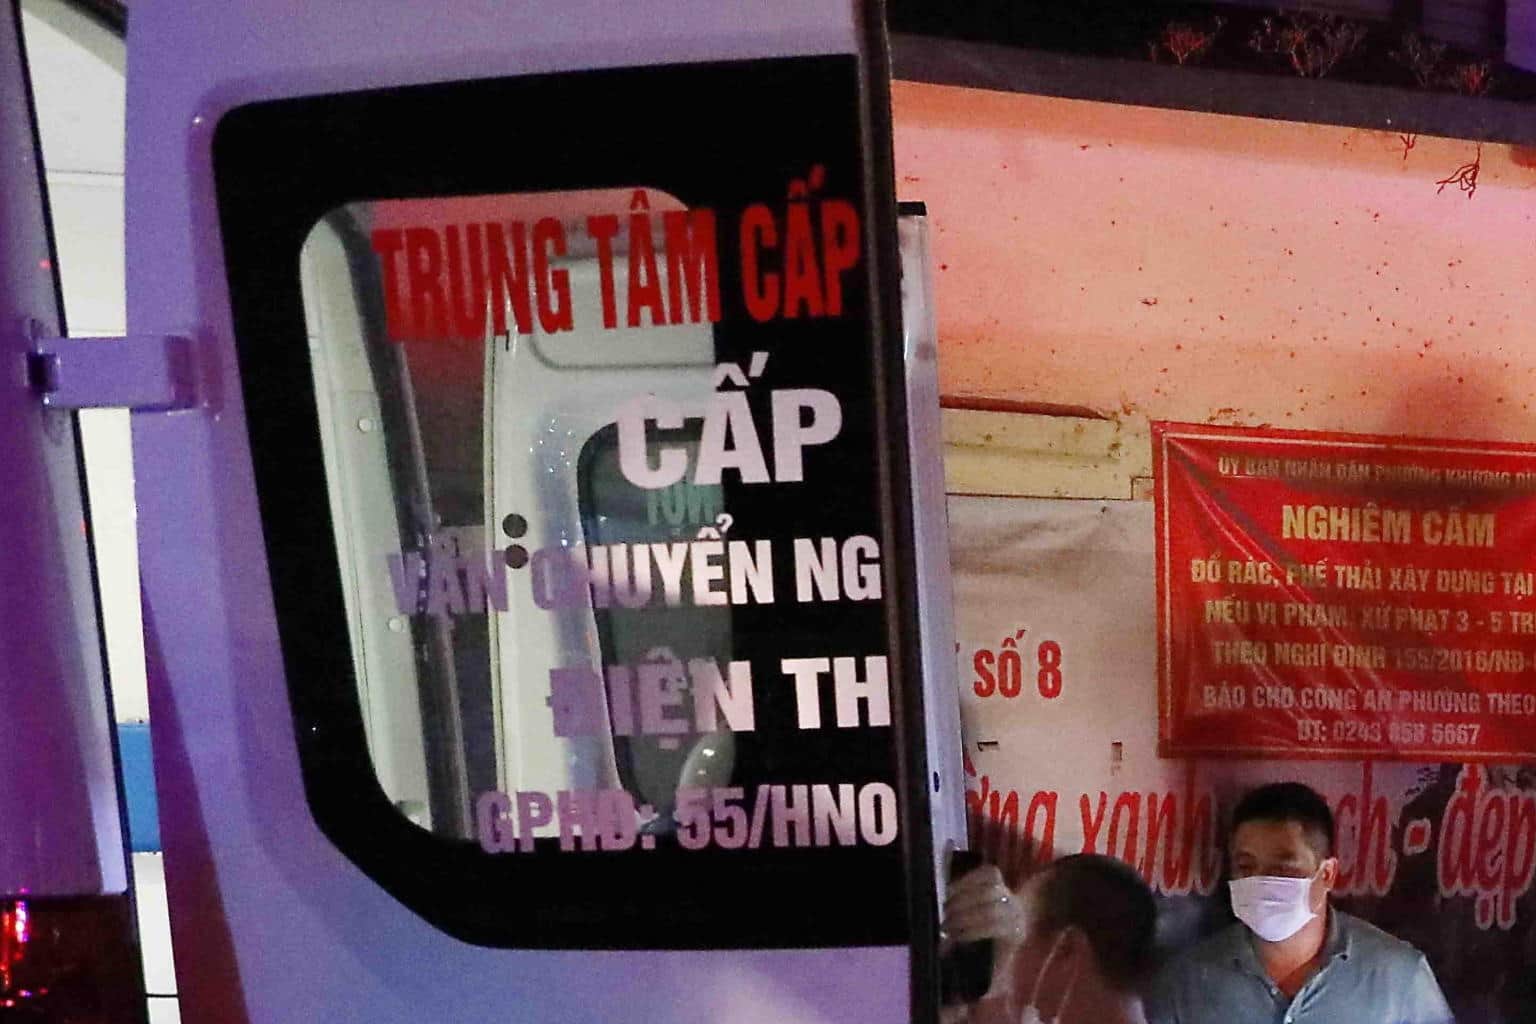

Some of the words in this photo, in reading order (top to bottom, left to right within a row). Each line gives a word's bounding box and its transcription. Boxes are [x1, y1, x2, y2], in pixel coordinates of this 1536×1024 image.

[372, 213, 574, 341] TRUNG
[588, 189, 721, 329] TÂM
[740, 164, 861, 322] CẤP
[615, 352, 843, 489] CẤP
[1282, 502, 1411, 544] NGHIÊM
[531, 514, 773, 612] CHUYỂN
[787, 535, 882, 602] NG
[1389, 563, 1430, 593] XÂY
[1503, 572, 1533, 602] TẠI
[546, 648, 755, 750] ĐIỆN
[781, 656, 891, 730] TH
[1038, 640, 1063, 699] 8
[1487, 691, 1536, 715] THEO
[675, 782, 898, 850] 55/HNO
